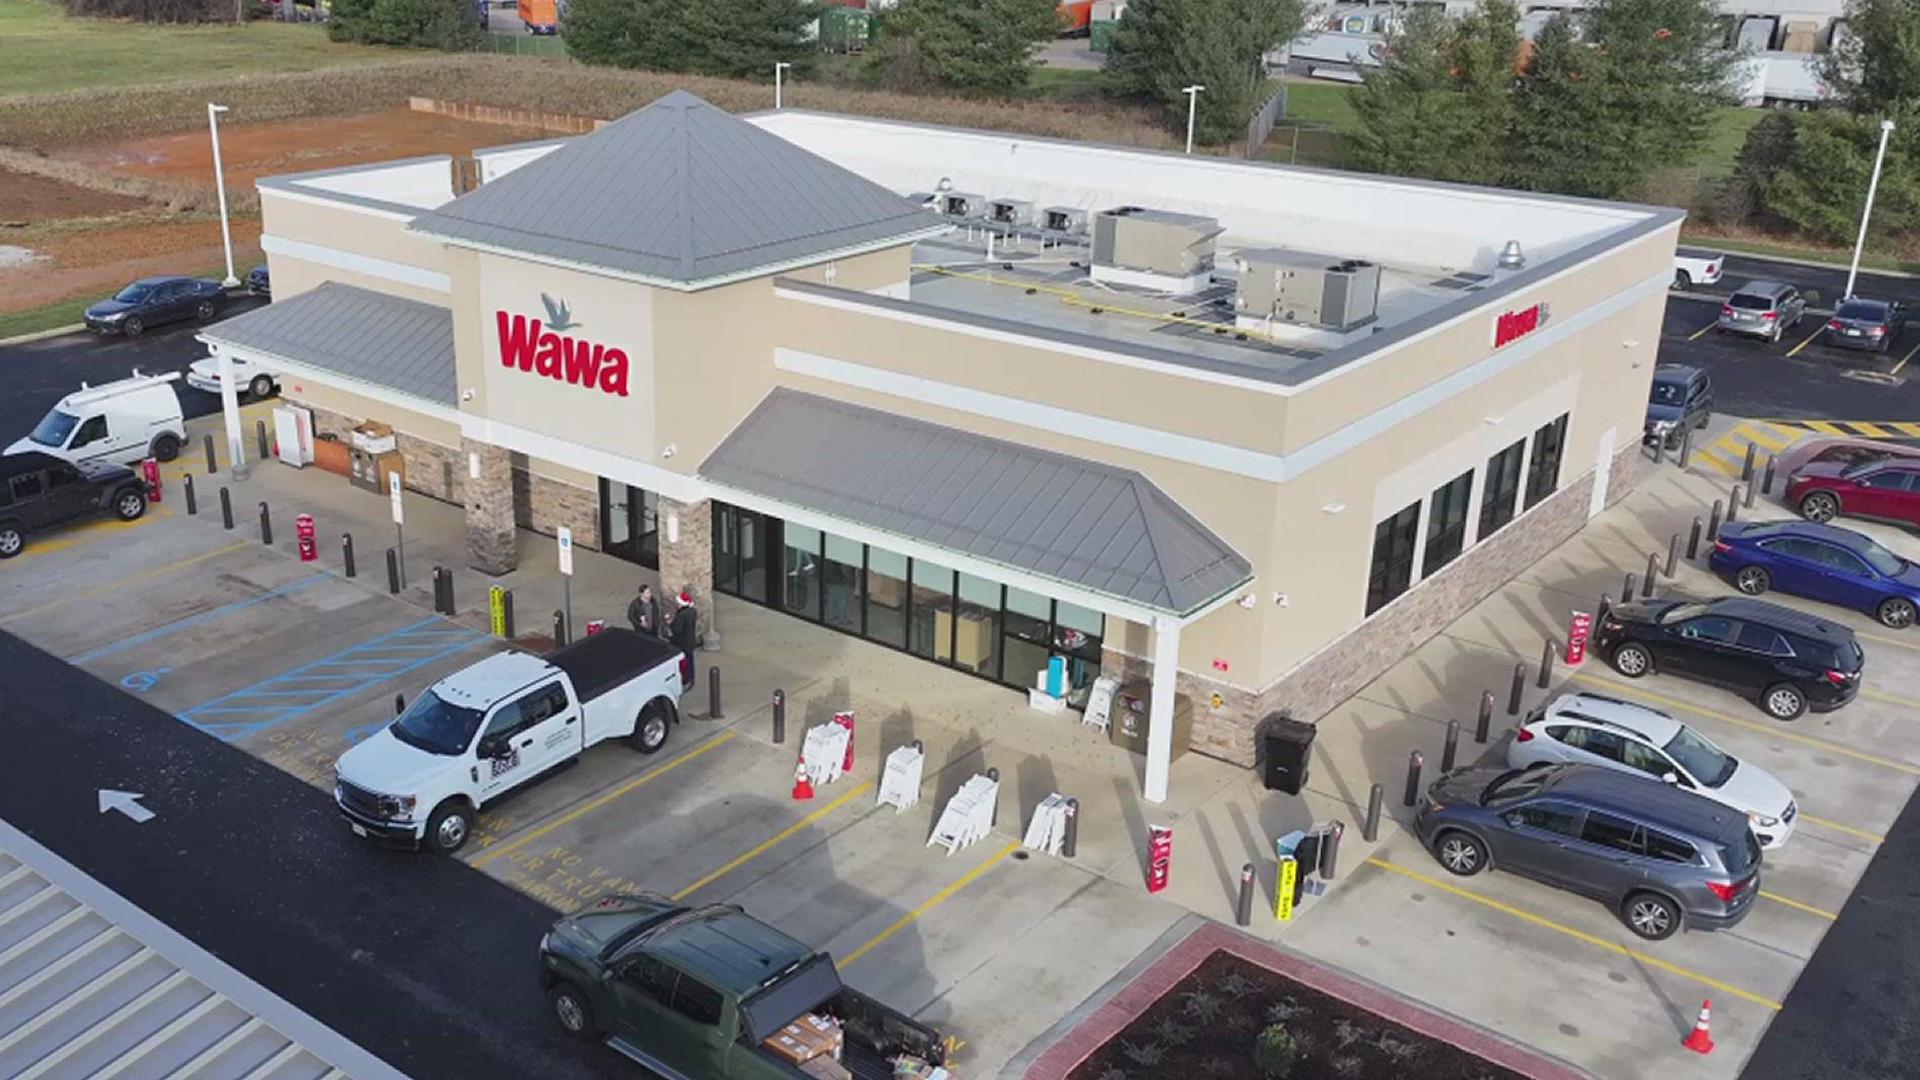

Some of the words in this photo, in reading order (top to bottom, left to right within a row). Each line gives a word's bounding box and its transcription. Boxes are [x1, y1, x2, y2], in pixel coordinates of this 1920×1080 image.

[496, 310, 630, 397] Wawa
[509, 851, 546, 871] OR
[546, 867, 602, 898] TRU
[547, 846, 583, 866] NO
